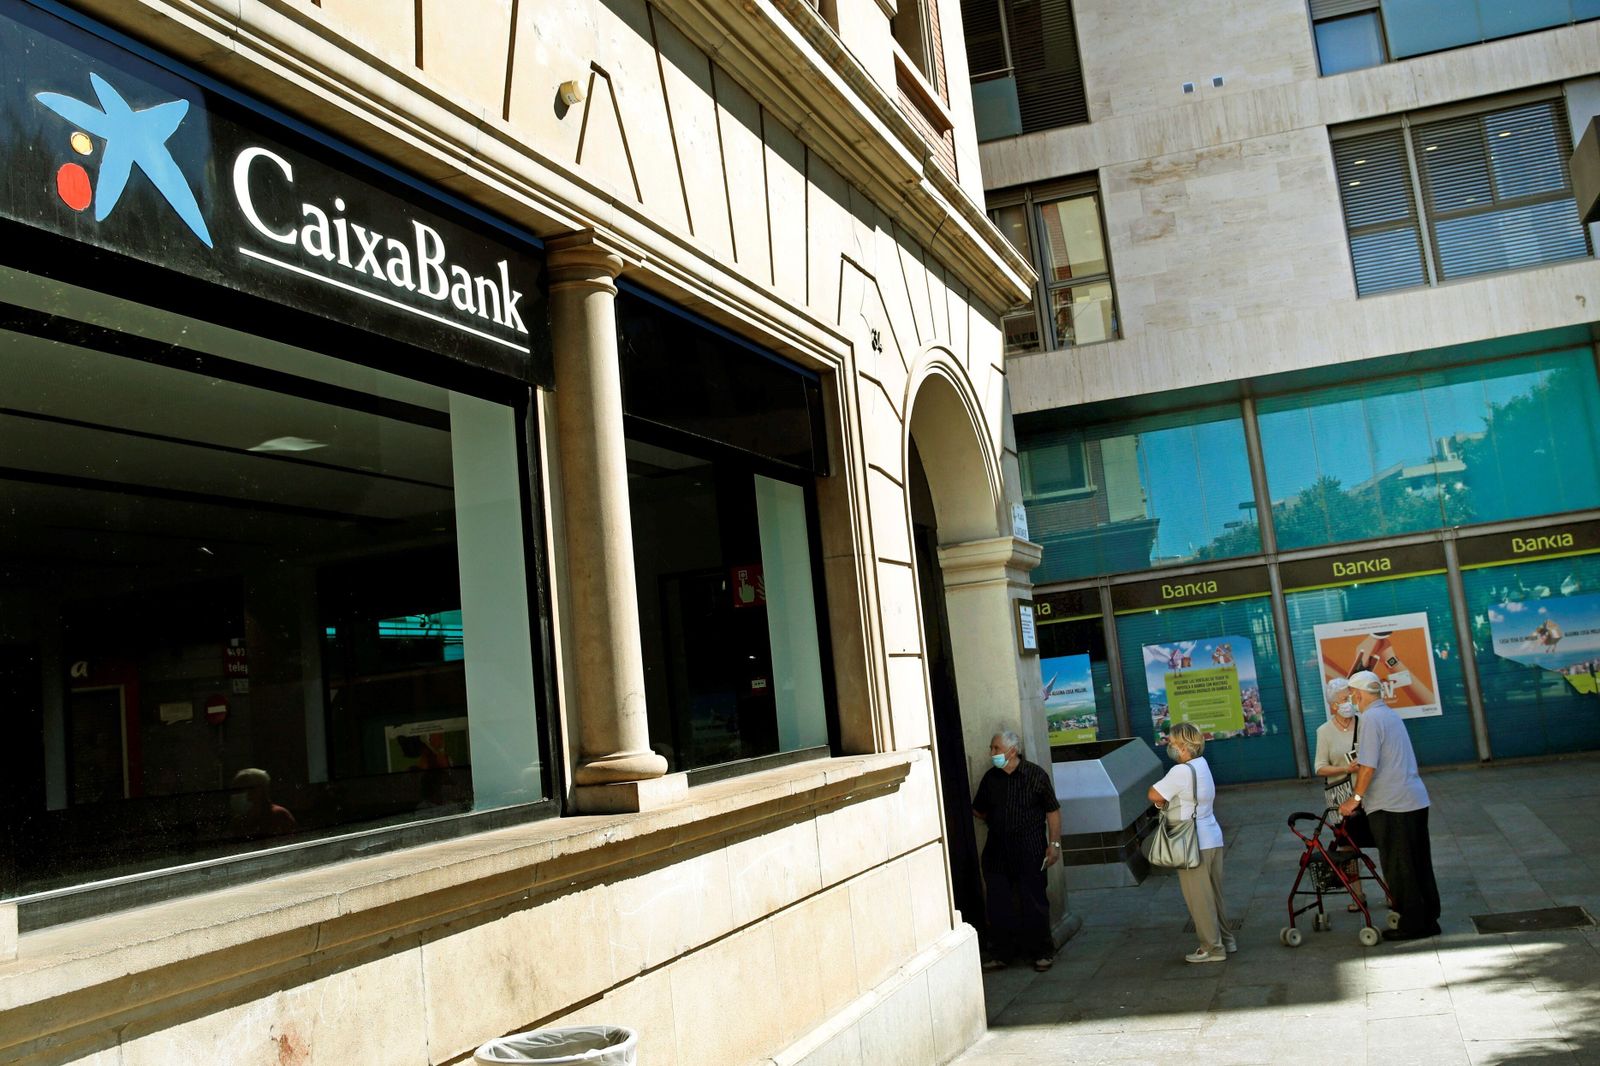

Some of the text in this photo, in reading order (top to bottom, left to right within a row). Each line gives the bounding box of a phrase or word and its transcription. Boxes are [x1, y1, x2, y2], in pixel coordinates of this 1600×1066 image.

[232, 146, 529, 335] CaixaBank
[1511, 533, 1574, 554] Bankia
[1332, 558, 1392, 578] Bankia
[1161, 580, 1218, 599] Bankia
